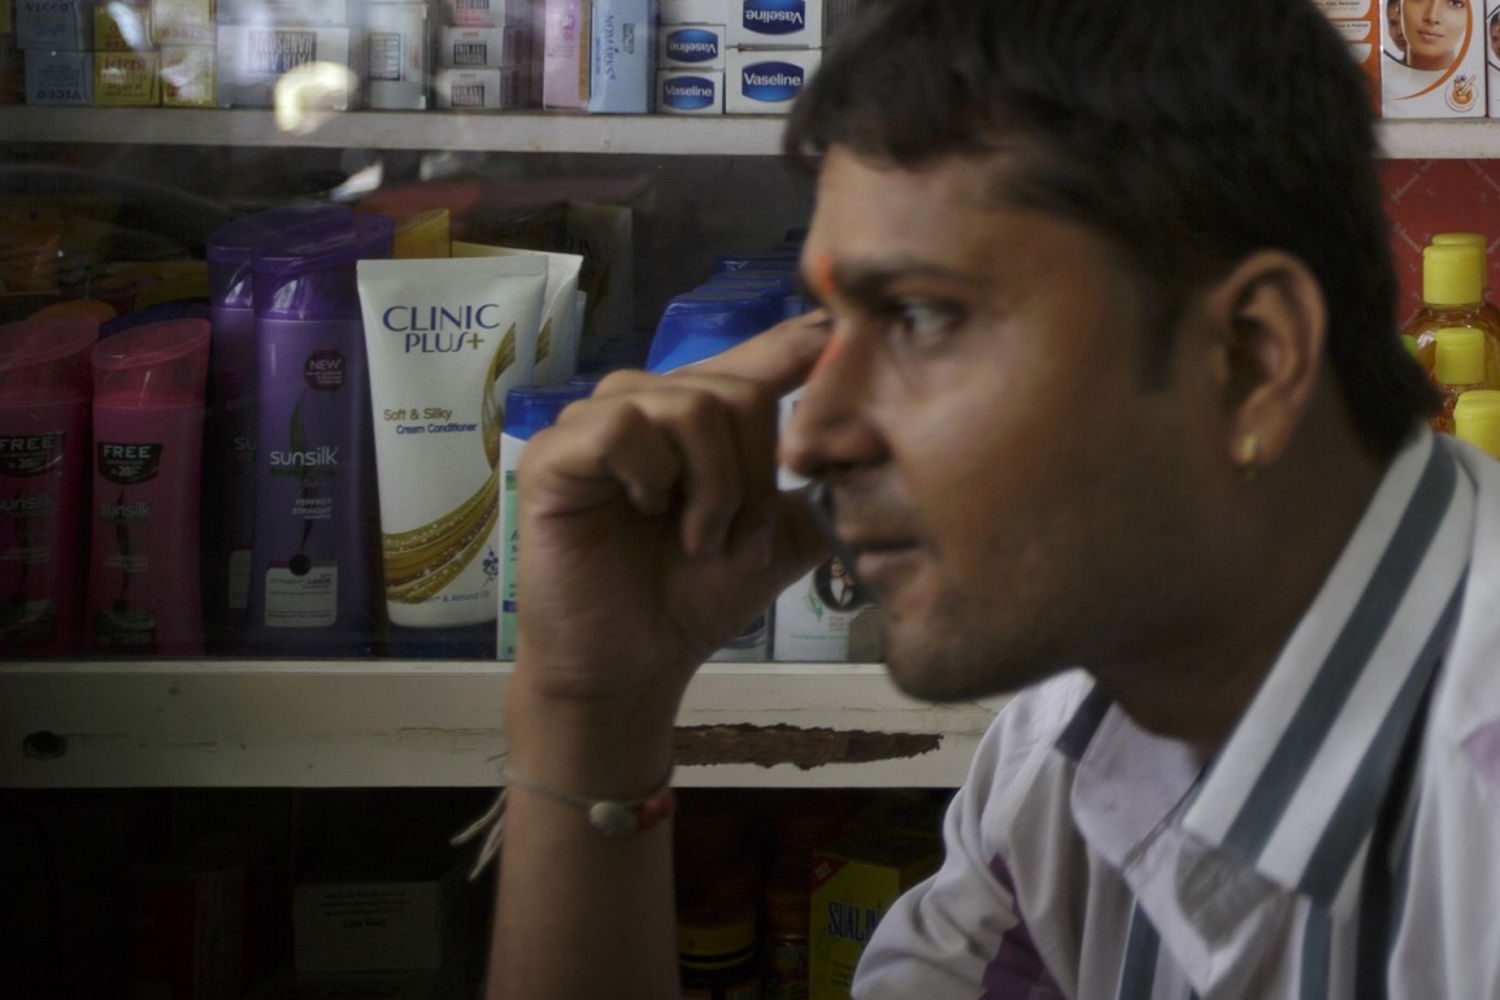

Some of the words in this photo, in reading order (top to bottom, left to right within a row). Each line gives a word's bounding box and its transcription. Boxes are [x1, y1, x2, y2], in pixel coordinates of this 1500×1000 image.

[25, 2, 70, 13] VICCO
[745, 9, 804, 25] Vaseline
[743, 73, 802, 88] Vaseline
[37, 89, 82, 100] VICCO
[664, 86, 713, 99] Vaseline
[382, 304, 500, 333] CLINIC
[404, 332, 486, 353] PLUS+
[309, 358, 342, 372] NEW
[383, 407, 407, 422] Soft
[409, 408, 420, 421] &
[422, 407, 453, 423] Silky
[395, 424, 426, 435] Cream
[426, 421, 479, 435] Conditioner
[102, 445, 151, 459] FREE
[269, 449, 339, 468] sunsilk
[100, 503, 152, 519] sunsilk
